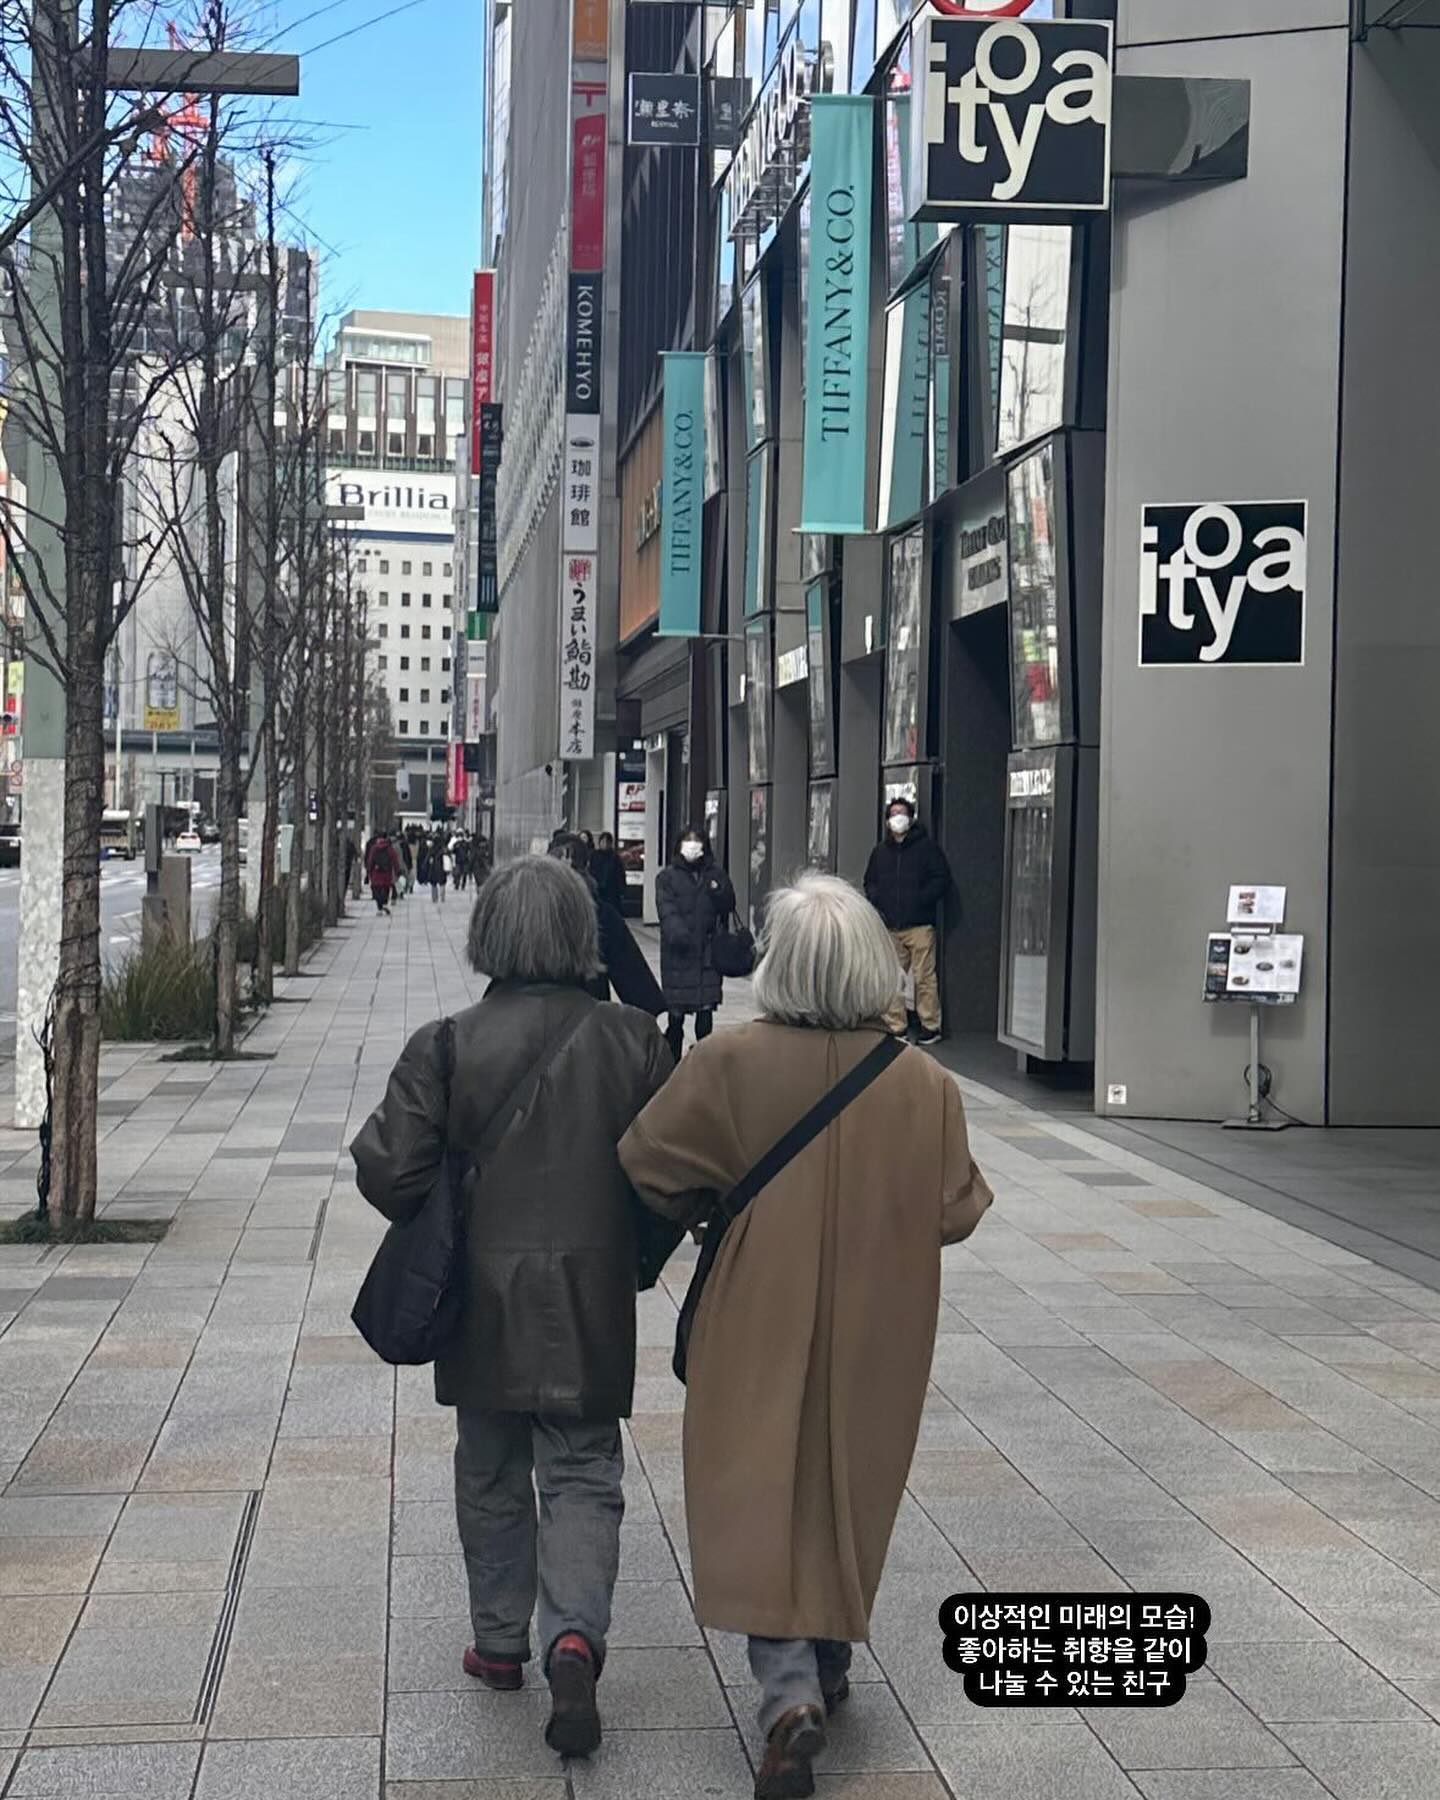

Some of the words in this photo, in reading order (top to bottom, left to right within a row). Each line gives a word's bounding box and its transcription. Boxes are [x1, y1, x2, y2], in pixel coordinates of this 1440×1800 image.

[576, 286, 593, 400] KOMEHYO
[338, 483, 450, 510] Brillia
[570, 459, 591, 527] 珈琲館
